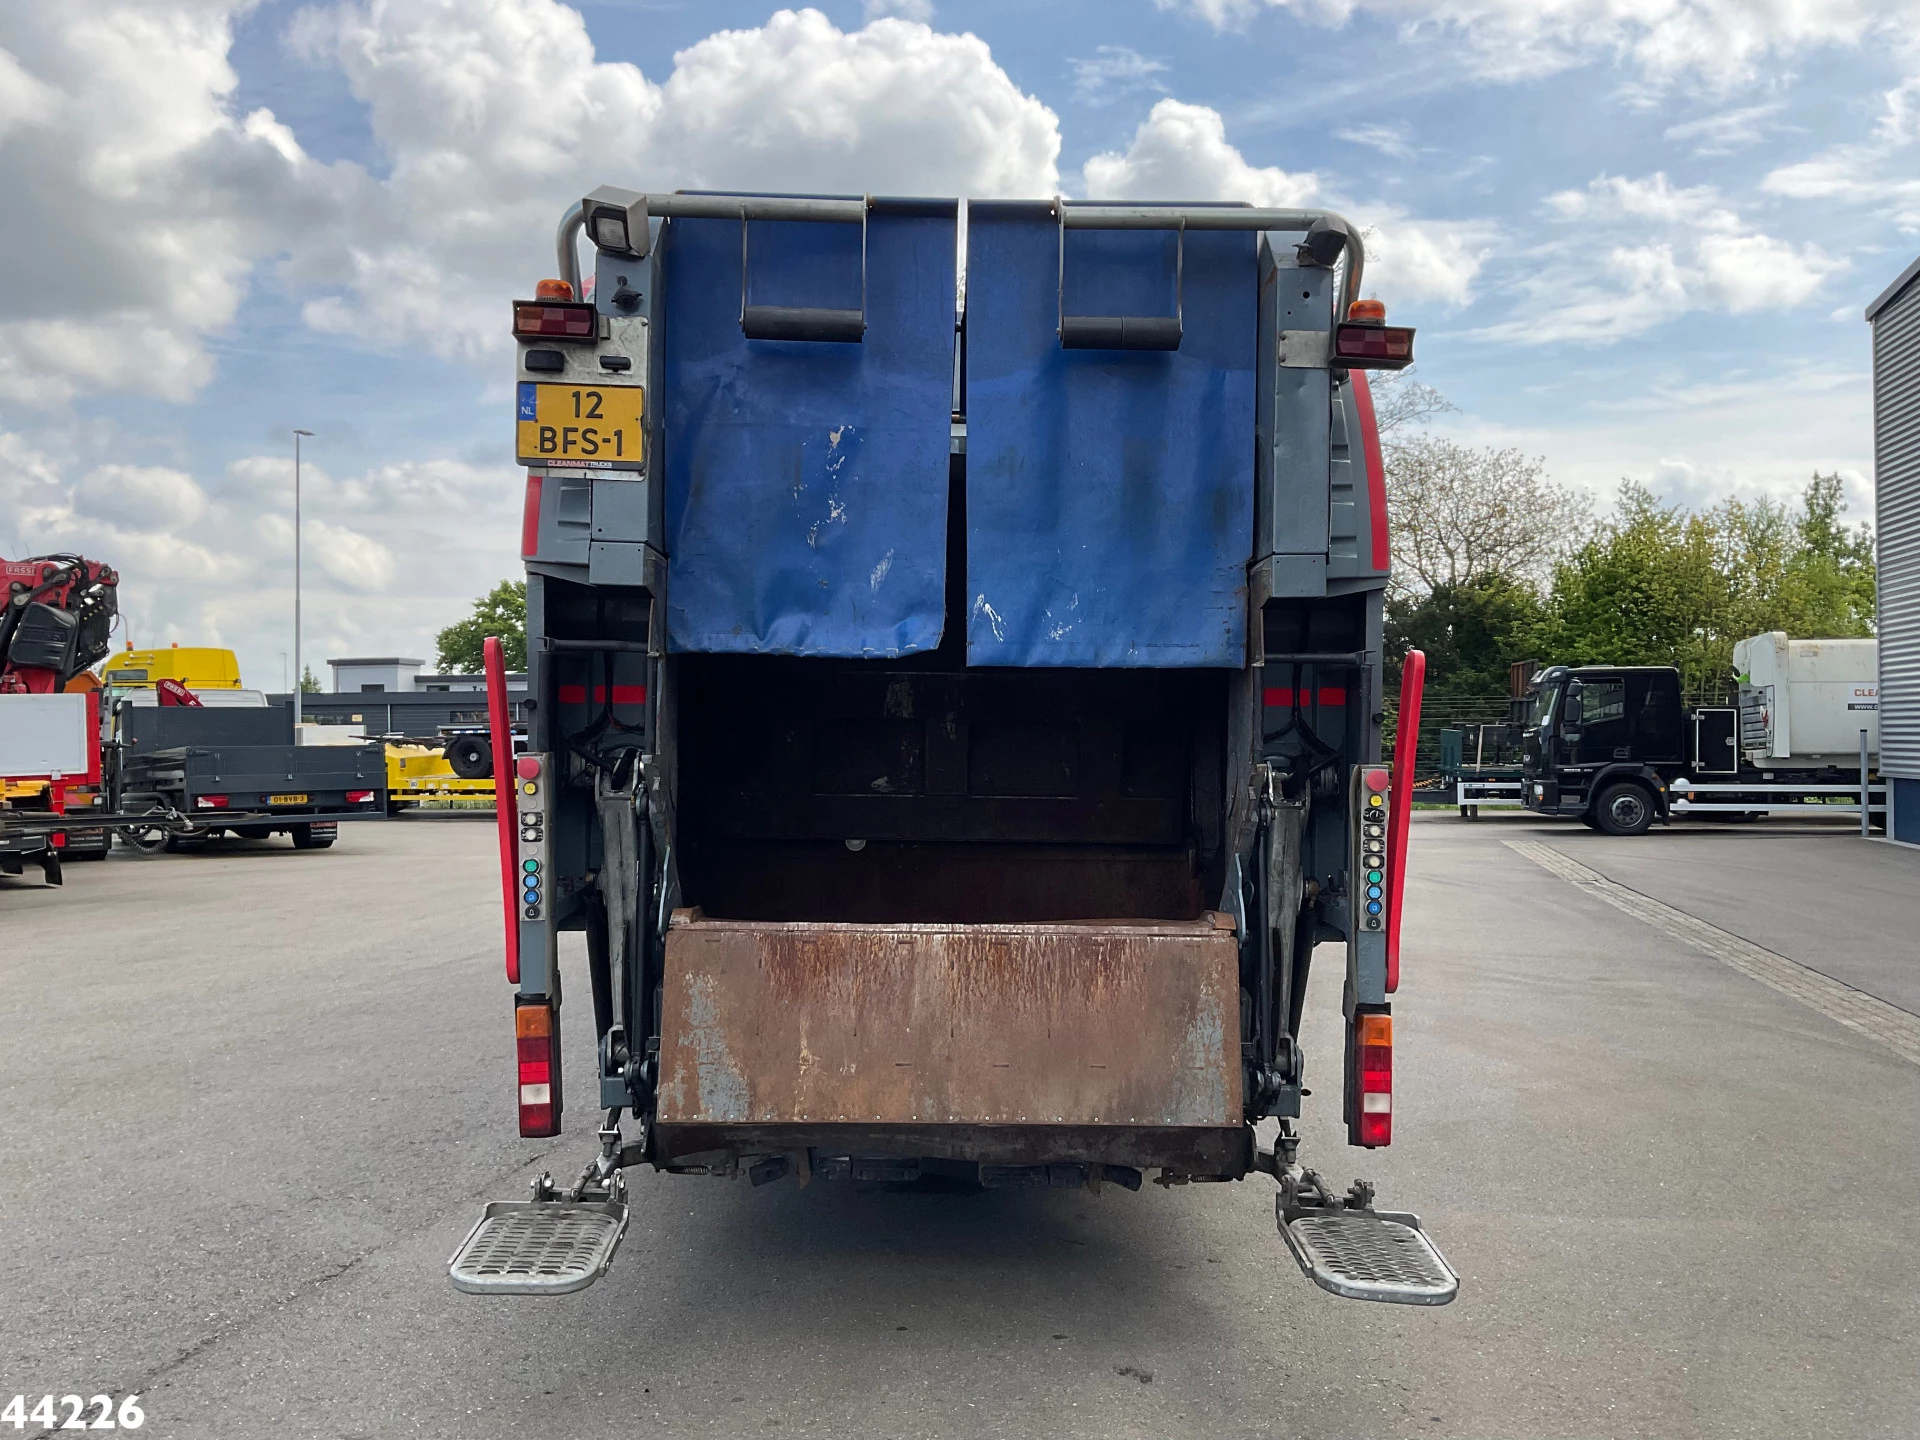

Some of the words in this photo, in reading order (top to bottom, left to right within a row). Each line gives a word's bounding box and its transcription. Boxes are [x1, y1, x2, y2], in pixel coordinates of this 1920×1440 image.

[521, 406, 534, 415] NL
[572, 391, 603, 419] 12
[539, 426, 622, 456] BFS-1
[8, 566, 35, 575] FASSI
